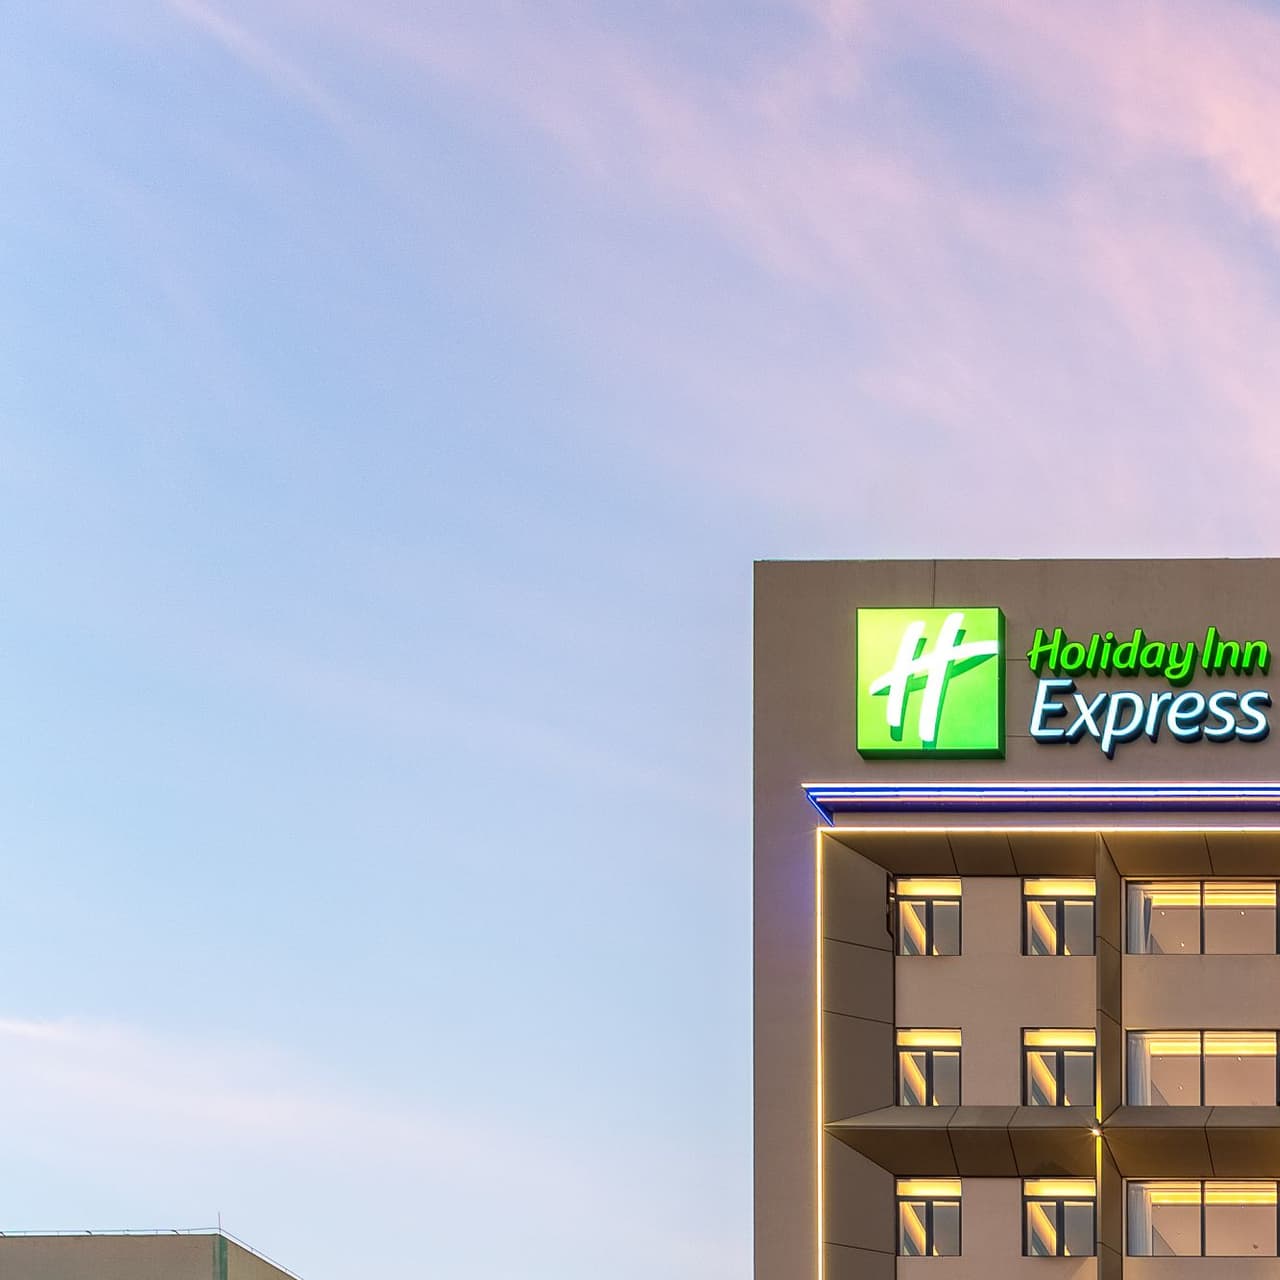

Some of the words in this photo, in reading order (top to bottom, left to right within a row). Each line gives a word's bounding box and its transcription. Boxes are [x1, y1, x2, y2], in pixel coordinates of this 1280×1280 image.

[1027, 627, 1195, 682] Holiday
[1201, 625, 1269, 671] Inn
[1030, 678, 1270, 756] Express
